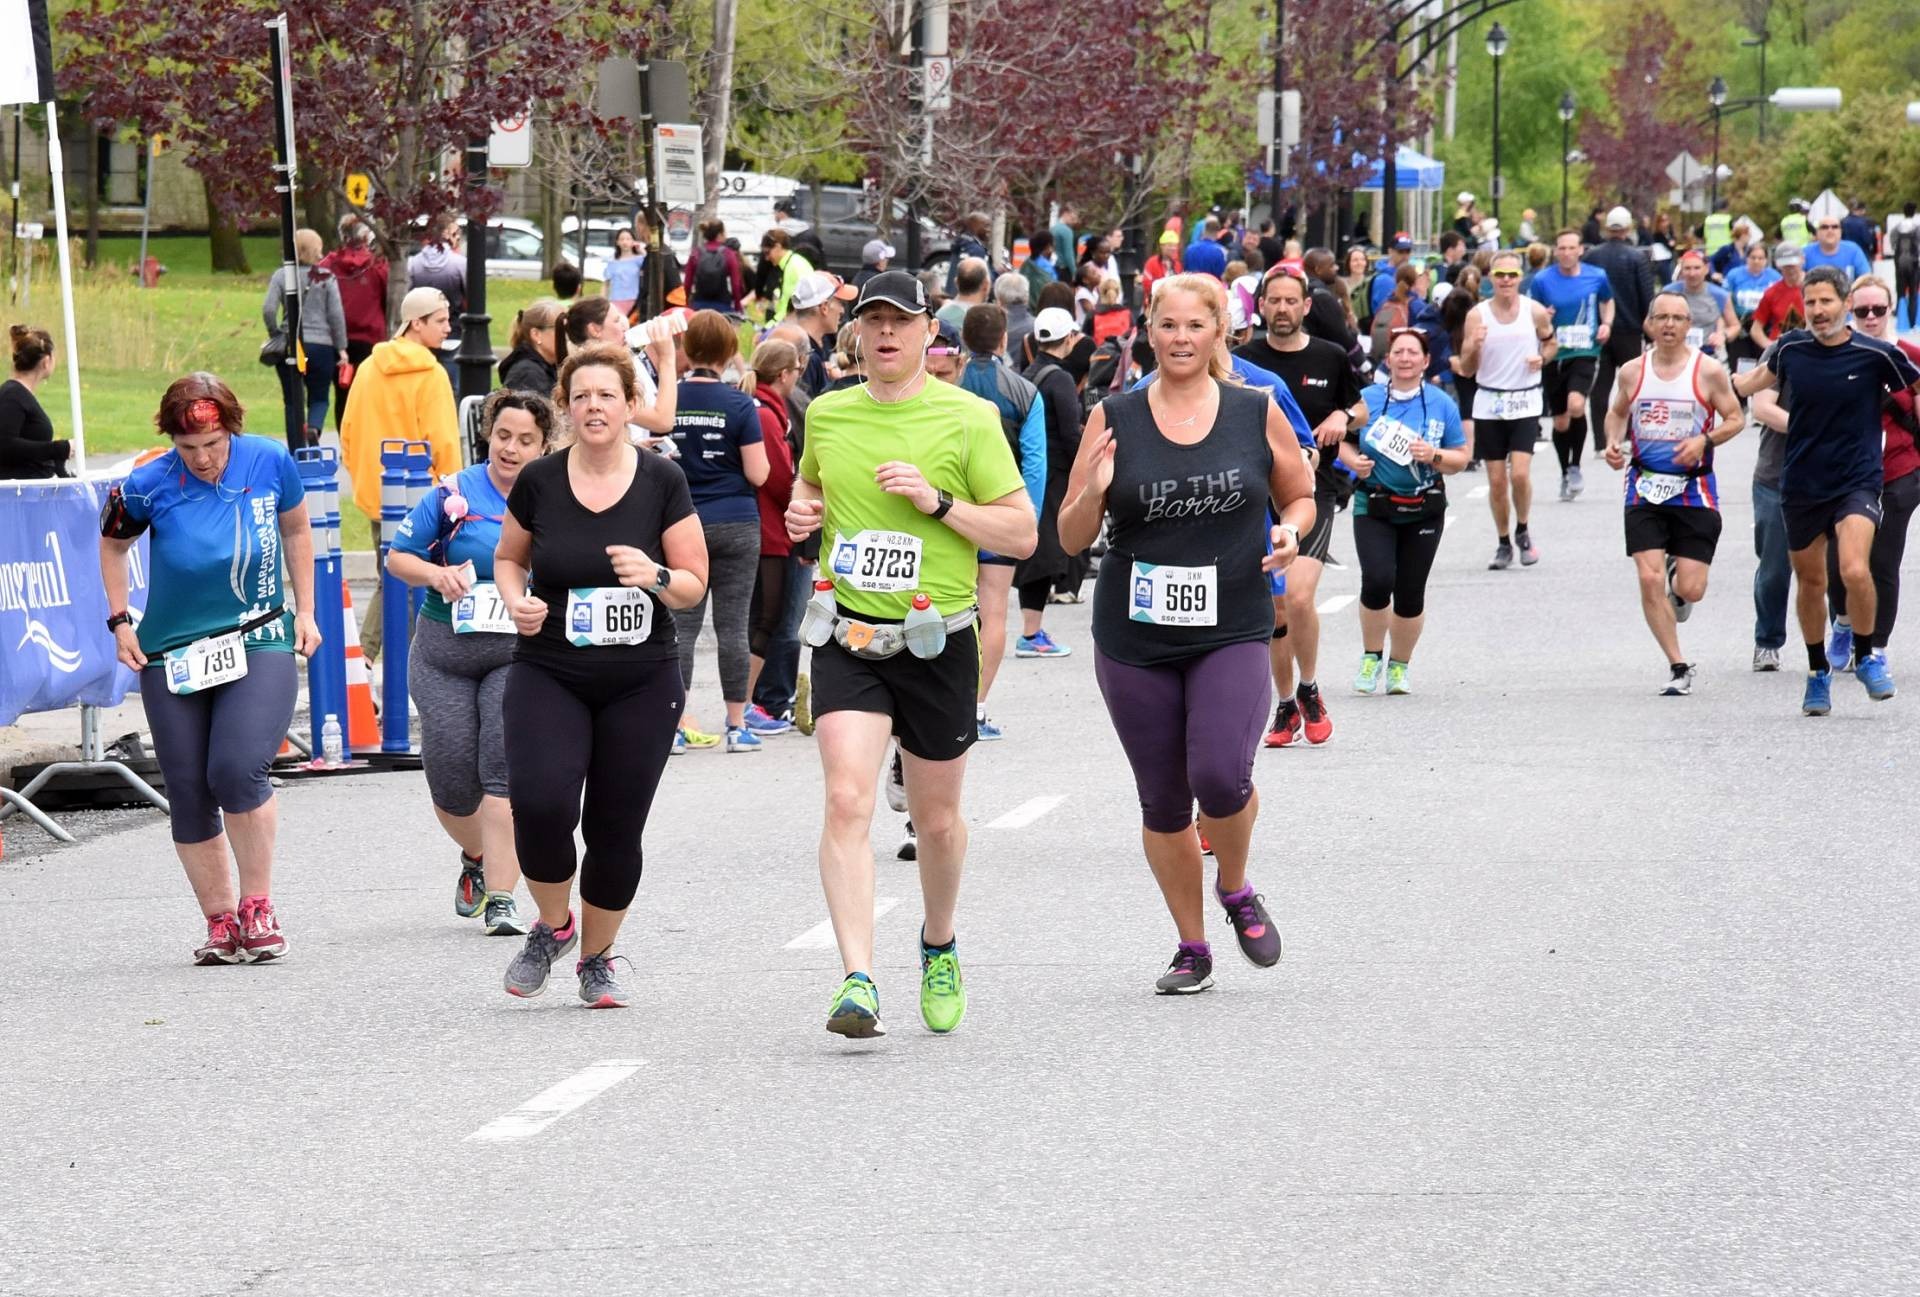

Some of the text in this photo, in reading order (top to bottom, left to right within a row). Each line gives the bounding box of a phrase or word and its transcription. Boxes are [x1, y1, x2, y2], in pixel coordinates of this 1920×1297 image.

[1139, 468, 1243, 504] UP THE
[1143, 491, 1247, 522] Barre
[257, 526, 271, 599] MARATHON
[861, 547, 916, 578] 3723
[1192, 571, 1203, 581] KM
[267, 575, 276, 597] DE
[1166, 583, 1207, 612] 569
[606, 603, 645, 633] 666
